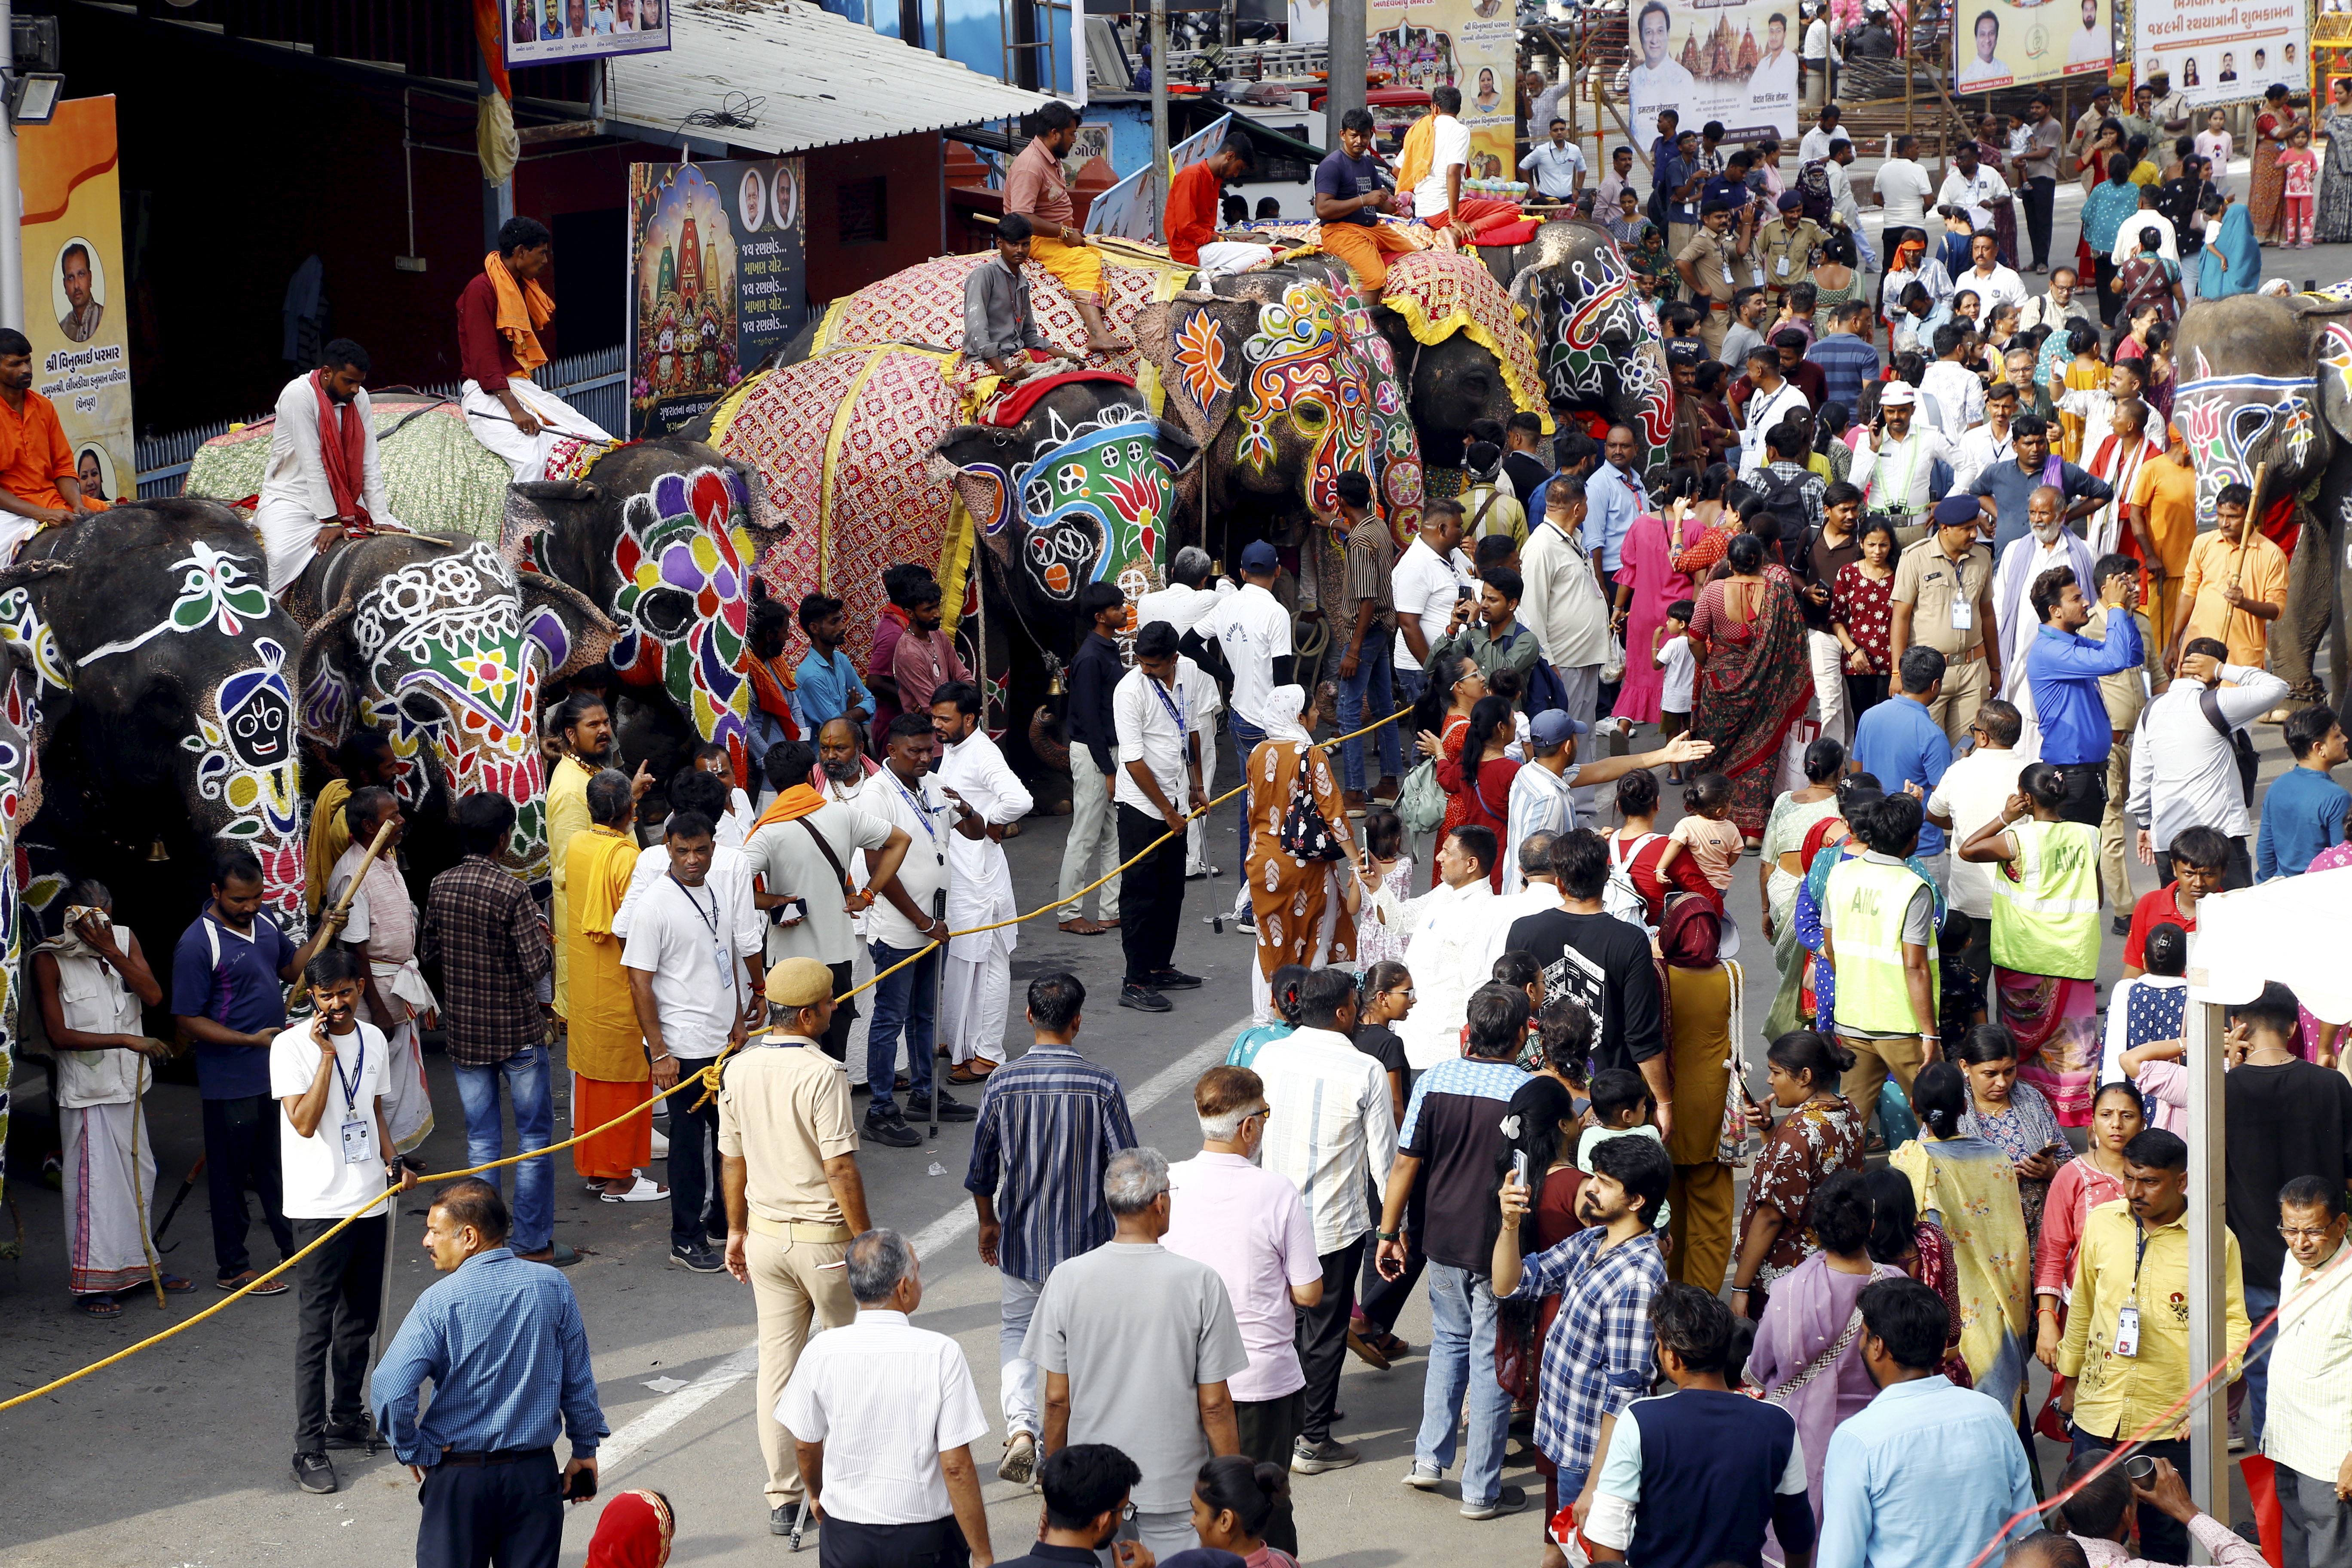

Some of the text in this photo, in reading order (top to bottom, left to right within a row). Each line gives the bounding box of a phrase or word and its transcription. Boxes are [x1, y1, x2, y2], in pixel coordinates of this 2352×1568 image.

[1075, 144, 1101, 156] ગોળ
[742, 243, 753, 256] જય
[744, 261, 766, 275] માખણ
[742, 283, 754, 296] જય
[744, 299, 766, 313] માખણ
[743, 321, 754, 334] જય
[46, 347, 119, 373] શ્રી વિનુભાઈ પરમાર
[91, 375, 107, 389] હનુમાન
[109, 369, 126, 382] પરિવાર
[660, 401, 714, 421] ગુજરાતના નાથ ભગવા
[1161, 698, 1170, 709] POLICE
[891, 778, 903, 792] GUJARAT
[906, 797, 926, 824] GUJARAT POLICE
[2055, 844, 2085, 873] AMC
[1851, 887, 1882, 916] AMC
[695, 910, 712, 920] THUDER
[1568, 951, 1579, 962] FIVE
[1582, 961, 1598, 975] GUYS
